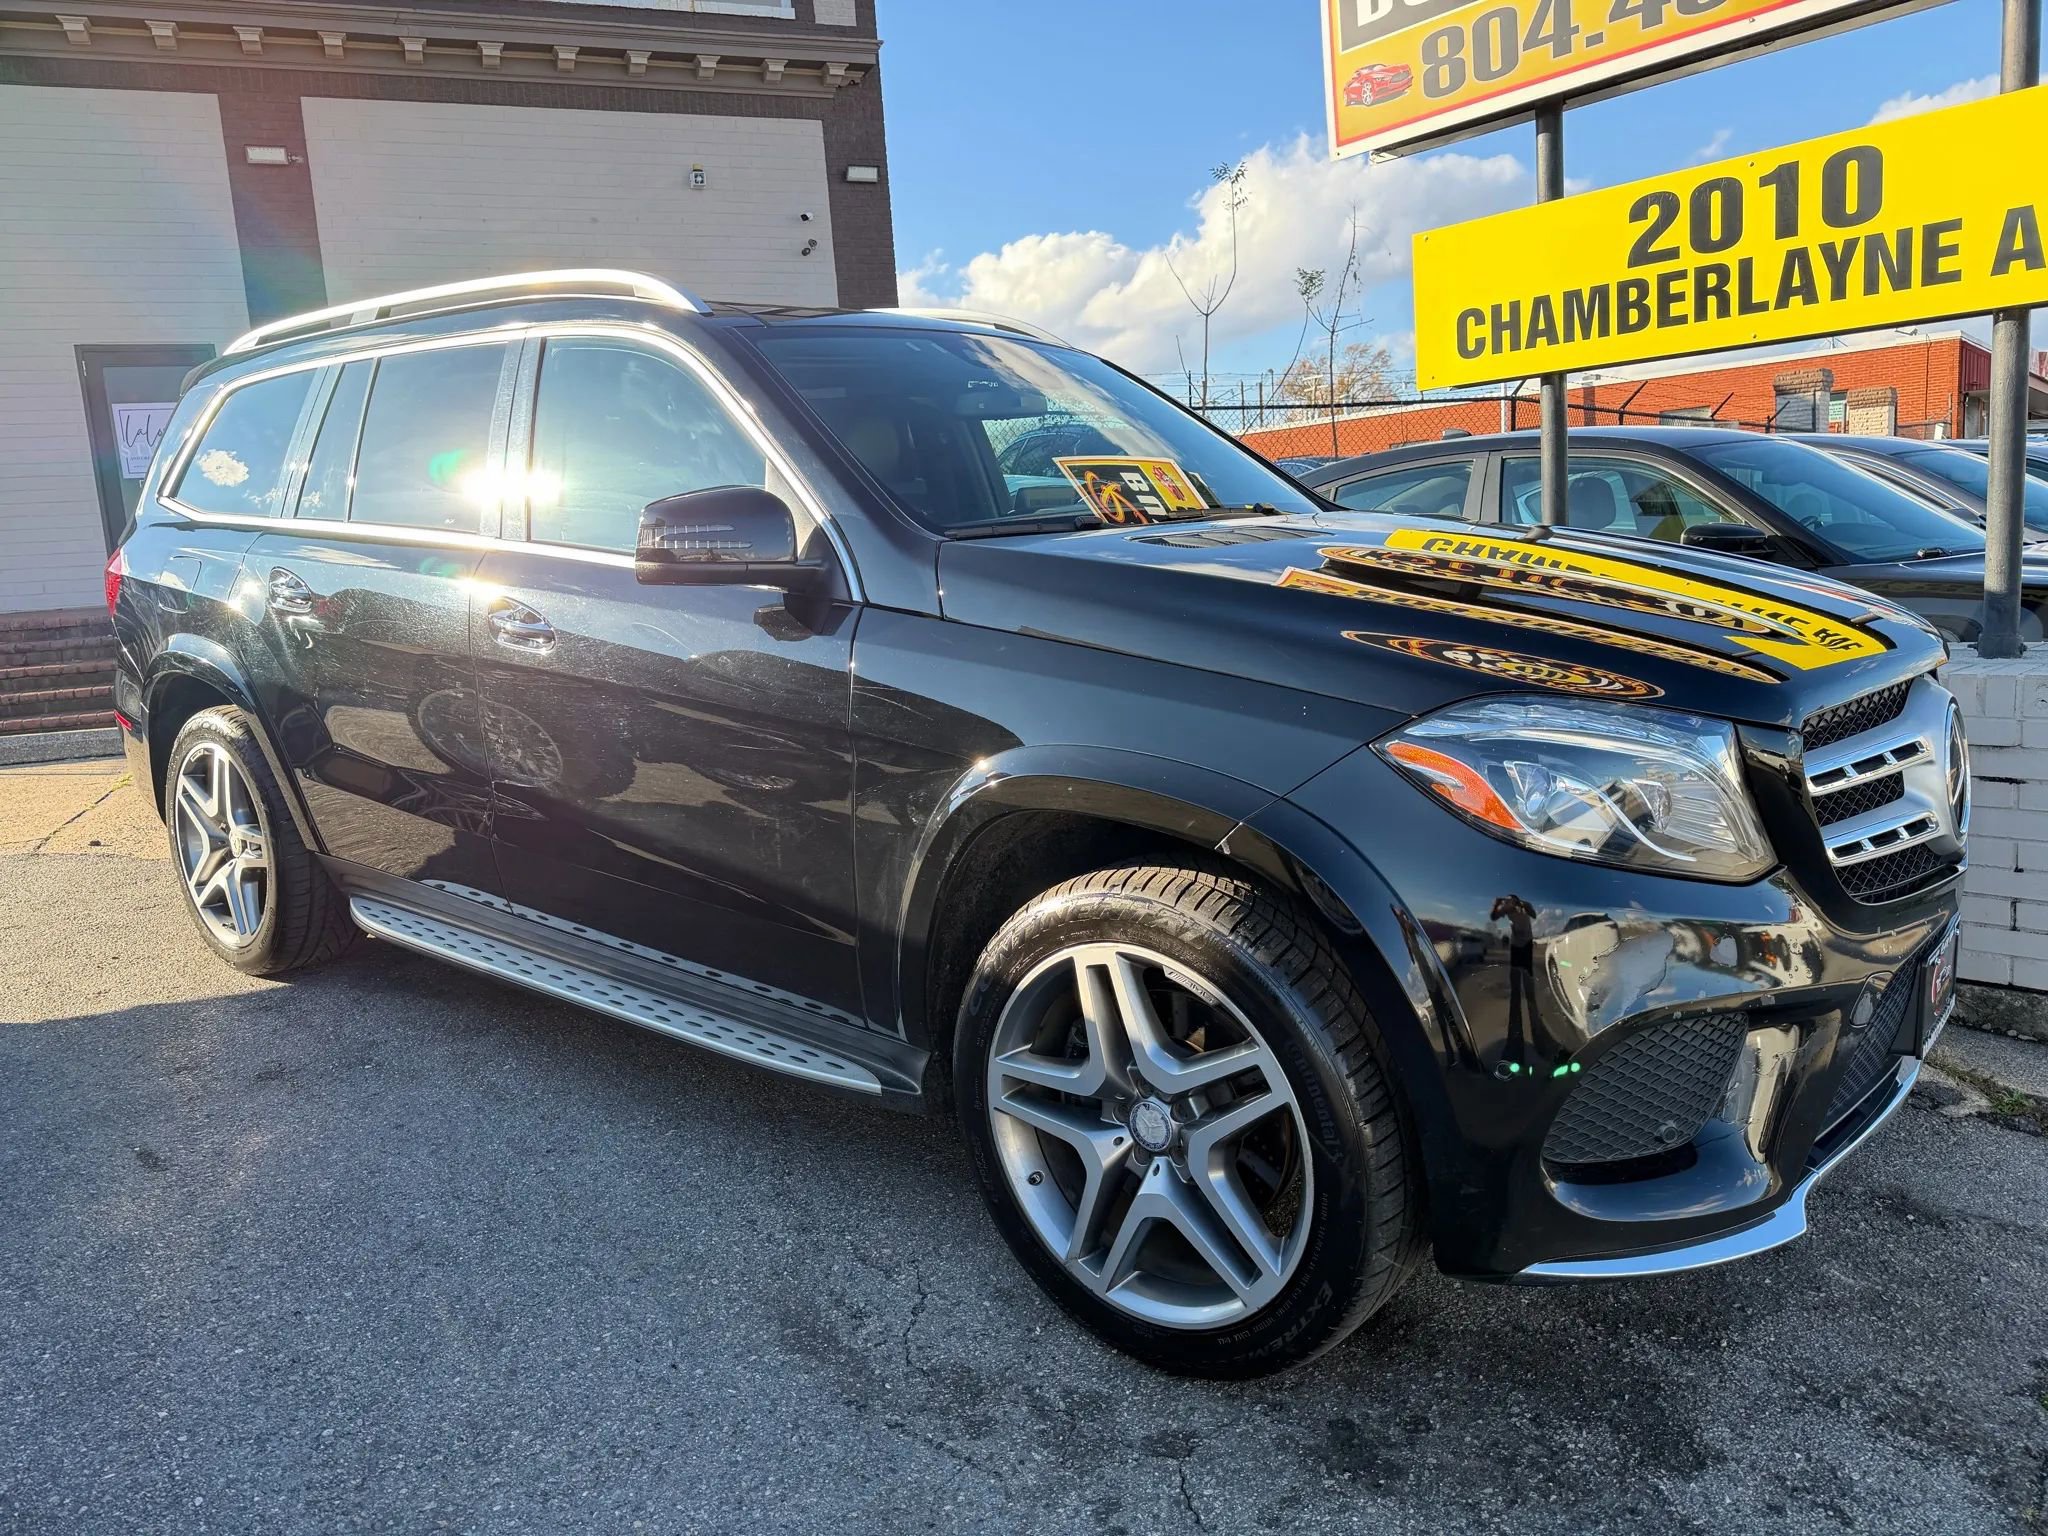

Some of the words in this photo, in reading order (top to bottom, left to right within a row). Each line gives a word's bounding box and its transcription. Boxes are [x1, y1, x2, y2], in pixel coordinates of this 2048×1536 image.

[1421, 0, 1729, 98] 804.4
[1627, 145, 1883, 269] 2010
[1456, 217, 1963, 360] CHAMBERLAYNE
[1990, 204, 2046, 277] A
